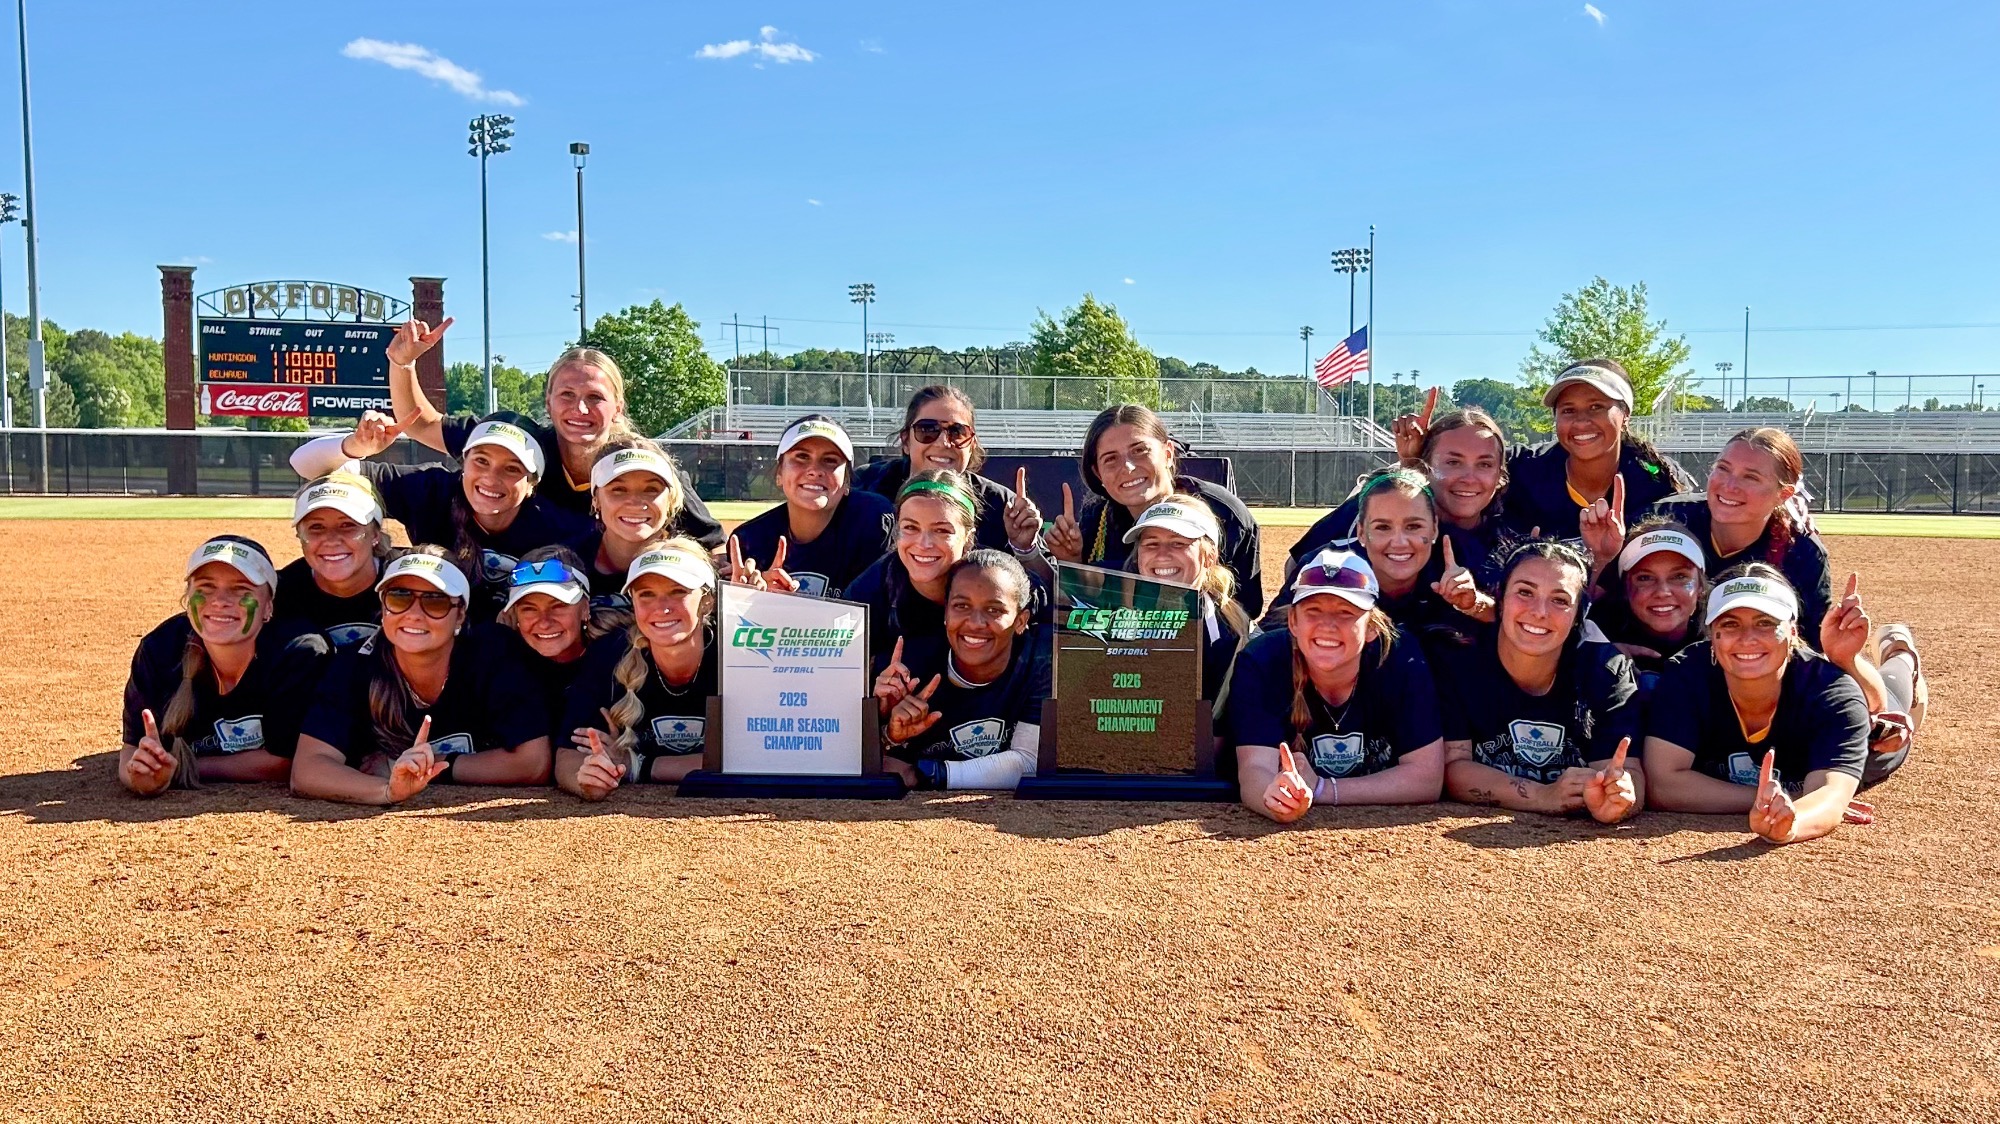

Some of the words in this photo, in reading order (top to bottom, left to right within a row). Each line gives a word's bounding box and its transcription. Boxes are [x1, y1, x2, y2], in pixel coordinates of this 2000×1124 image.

[224, 282, 385, 319] OXFORD
[203, 325, 226, 334] BALL
[249, 327, 282, 336] STRIKE
[305, 329, 324, 337] OUT
[345, 330, 379, 340] BATTER
[208, 353, 257, 363] HUNTINGDON
[209, 370, 248, 379] BELHAVEN
[216, 390, 305, 412] Coca-Cola
[313, 397, 393, 408] POWERAD
[1641, 534, 1683, 546] Belhaven
[1723, 582, 1768, 595] Belhaven
[1067, 609, 1113, 629] CCS
[1115, 609, 1189, 620] COLLEGIATE
[1112, 620, 1172, 628] CONFERENCE
[732, 627, 778, 648] CCS
[780, 627, 855, 639] COLLEGIATE
[1110, 629, 1135, 639] THE
[1136, 629, 1177, 639] SOUTH
[778, 639, 838, 647] CONFERENCE
[777, 647, 801, 657] THE
[802, 648, 843, 658] SOUTH
[1106, 647, 1149, 656] SOFTBALL
[773, 666, 815, 674] SOFTBALL
[1112, 673, 1142, 688] 2026
[779, 692, 808, 707] 2026
[1089, 698, 1164, 714] TOURNAMENT
[747, 717, 794, 732] REGULAR
[798, 718, 840, 733] SEASON
[1097, 717, 1156, 732] CHAMPION
[764, 735, 823, 751] CHAMPION
[962, 734, 996, 745] SOFTBALL
[1520, 737, 1554, 747] SOFTBALL
[1322, 751, 1357, 760] SOFTBALL
